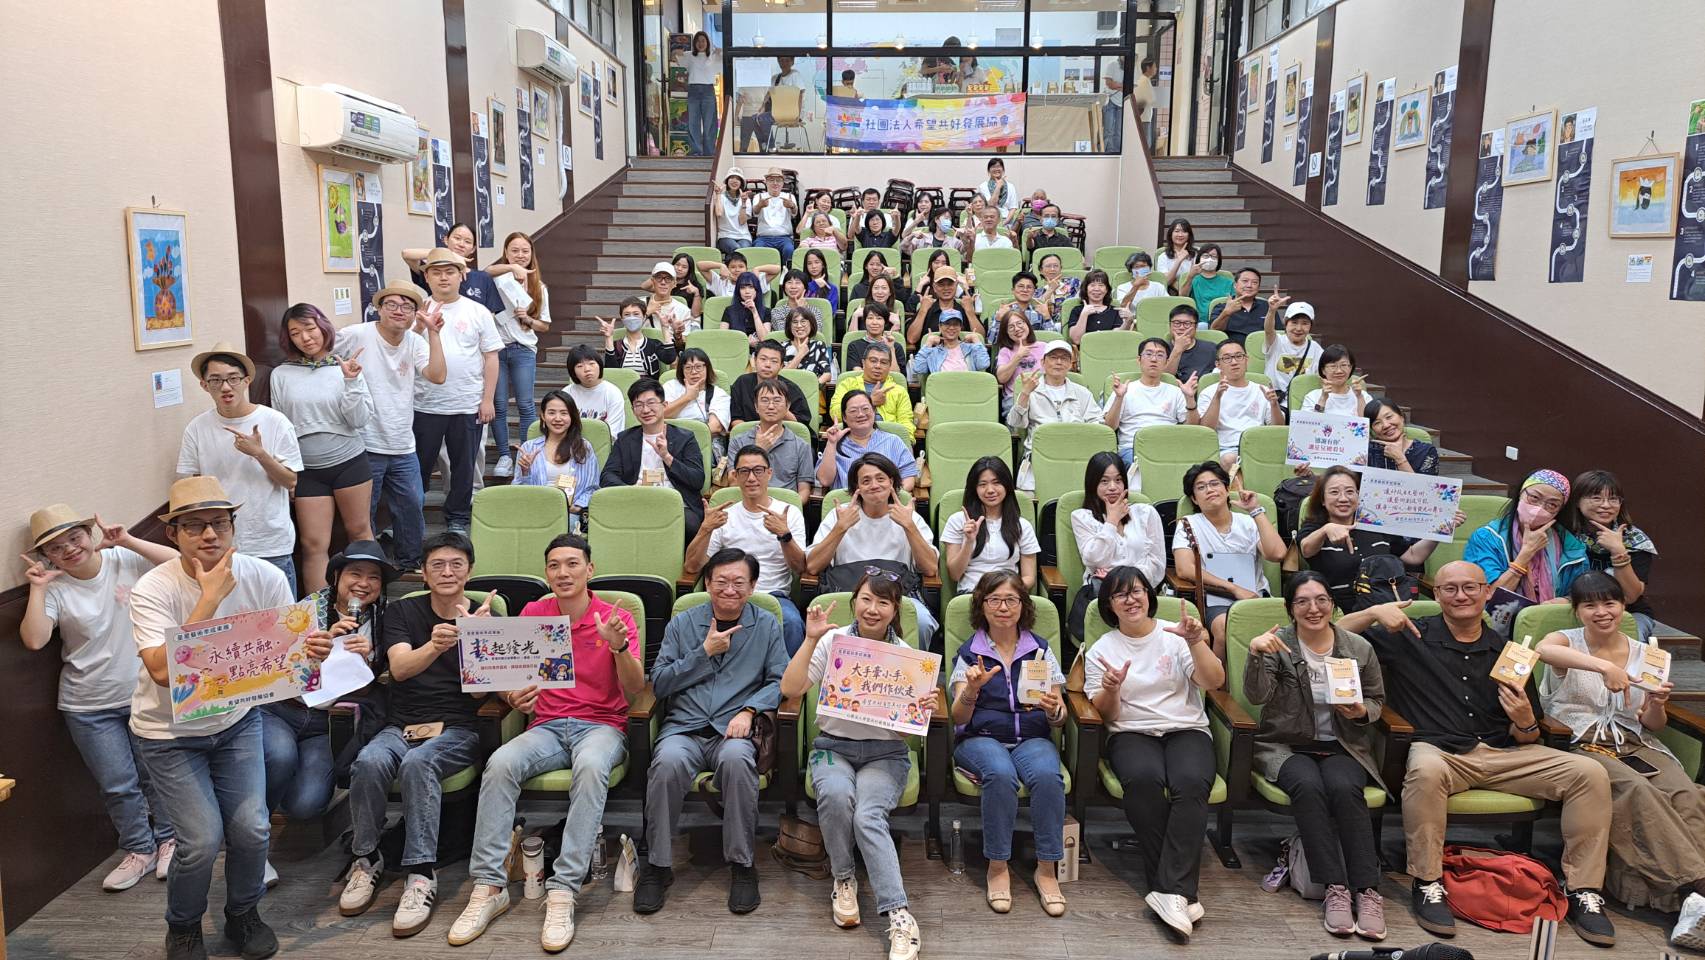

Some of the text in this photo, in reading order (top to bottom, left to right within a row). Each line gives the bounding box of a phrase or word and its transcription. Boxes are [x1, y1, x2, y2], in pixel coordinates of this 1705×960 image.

[865, 114, 1009, 131] 社團法人希望共好發展協會
[229, 653, 288, 680] 點亮希望
[860, 680, 916, 698] 我們作伙走
